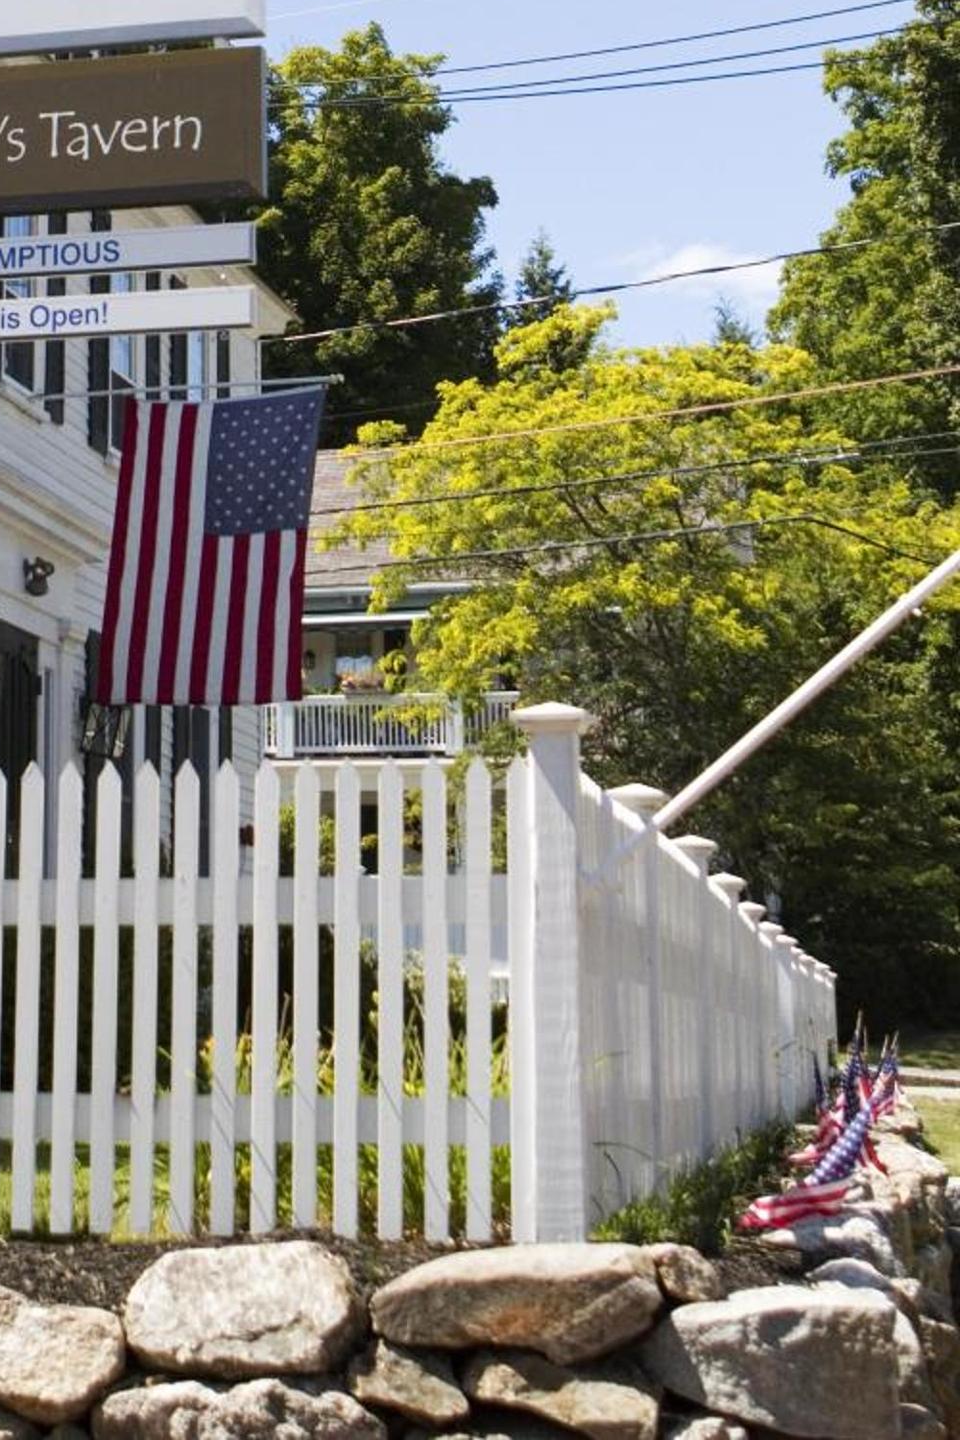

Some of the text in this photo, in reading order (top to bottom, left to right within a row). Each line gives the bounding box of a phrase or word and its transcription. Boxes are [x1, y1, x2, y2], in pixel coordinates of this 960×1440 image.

[39, 111, 202, 160] Tavern
[0, 307, 20, 330] is
[30, 302, 108, 333] Open!
